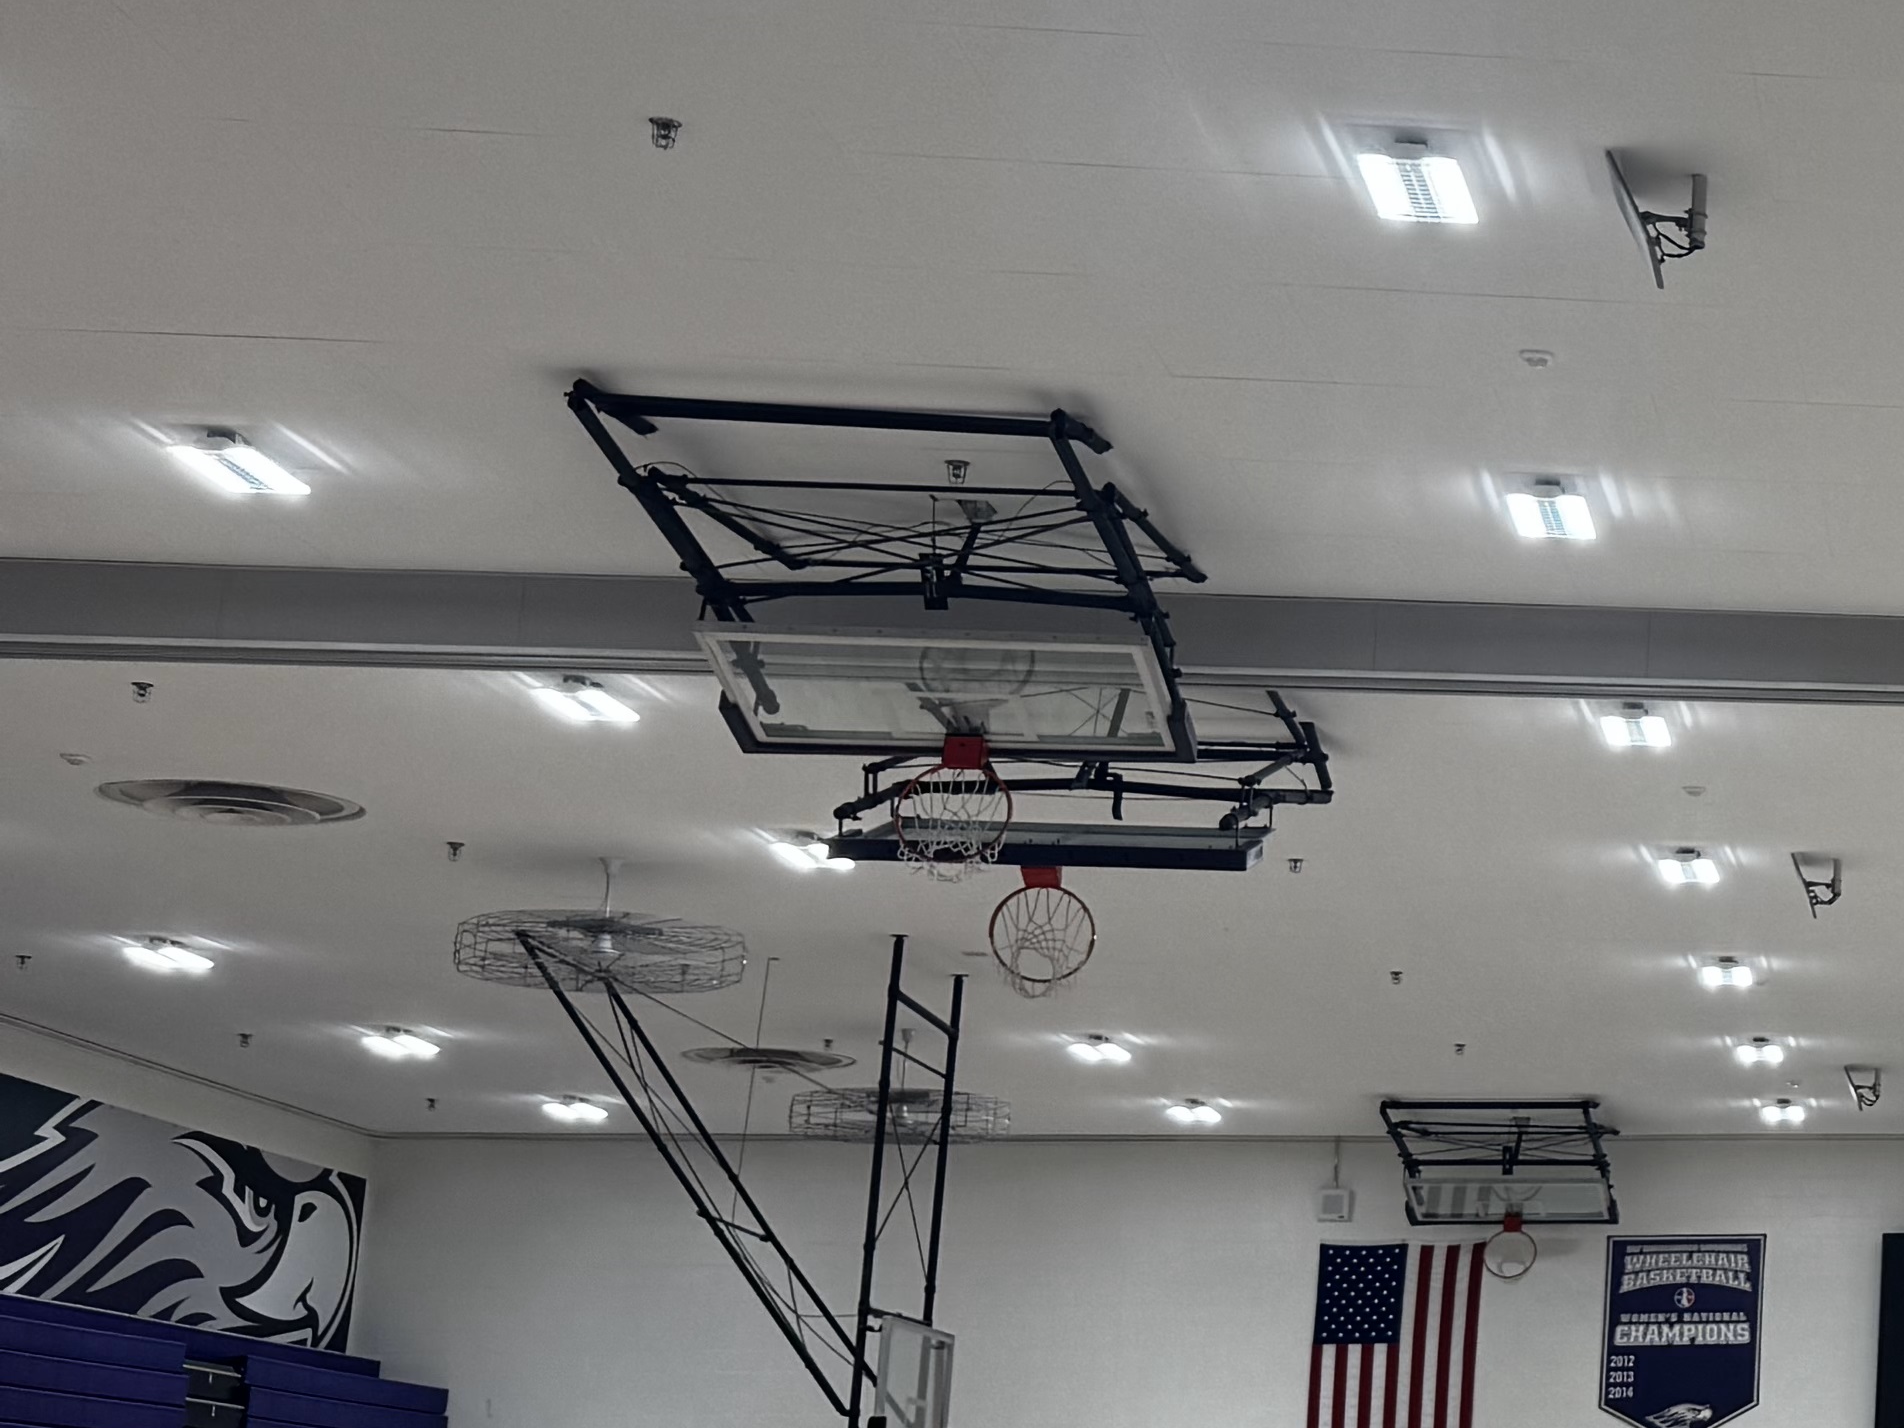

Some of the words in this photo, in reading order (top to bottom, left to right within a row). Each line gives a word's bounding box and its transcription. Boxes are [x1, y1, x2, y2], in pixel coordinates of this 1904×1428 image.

[1624, 1252, 1751, 1272] WHEELCHAIR
[1619, 1268, 1752, 1293] BASKETBALL
[1620, 1312, 1678, 1322] WOMEN'S
[1683, 1311, 1747, 1321] NATIONAL
[1614, 1323, 1750, 1345] CHAMPIONS
[1609, 1355, 1635, 1367] 2012
[1609, 1371, 1634, 1382] 2013
[1608, 1387, 1633, 1398] 2014
